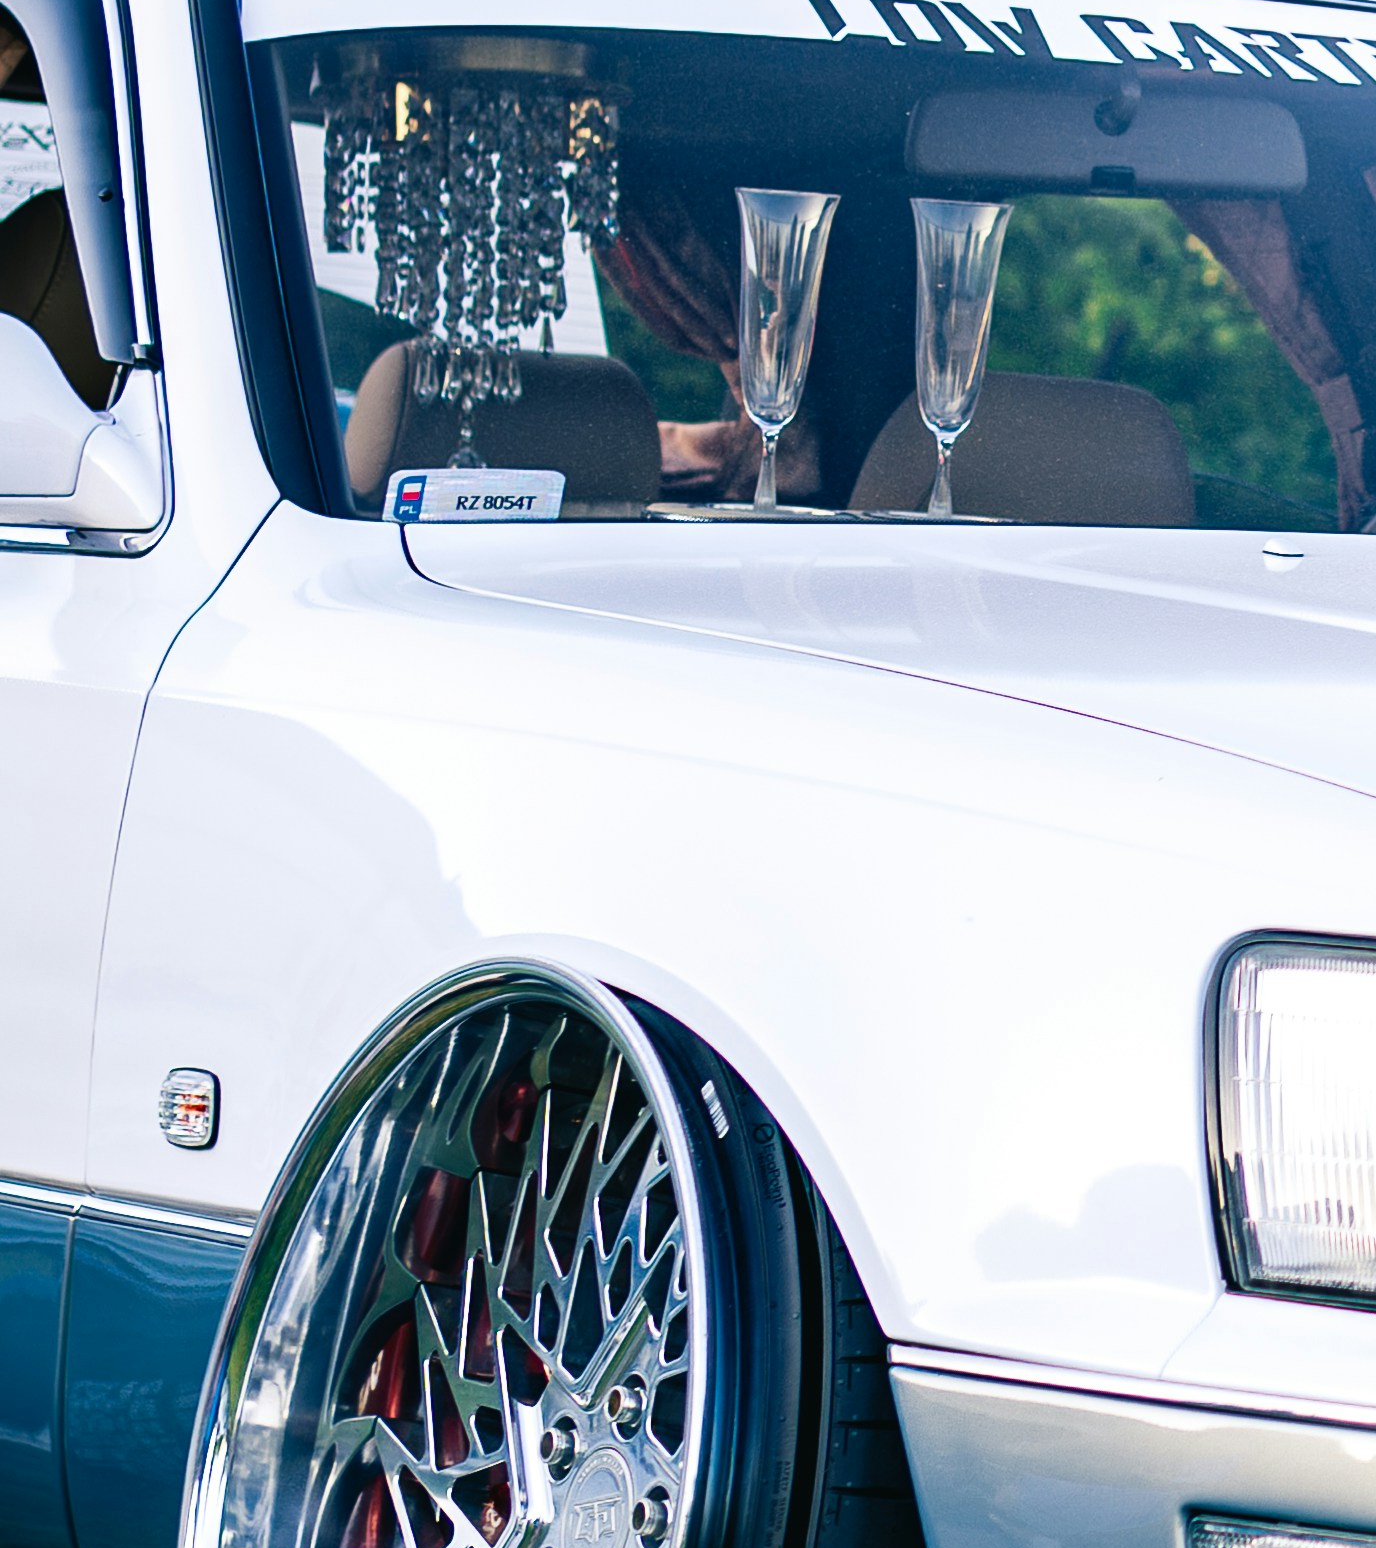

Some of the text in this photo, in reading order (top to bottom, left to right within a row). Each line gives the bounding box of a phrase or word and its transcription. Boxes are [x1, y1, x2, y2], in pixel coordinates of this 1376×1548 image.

[455, 495, 537, 511] RZ 8054T
[399, 505, 417, 515] PL
